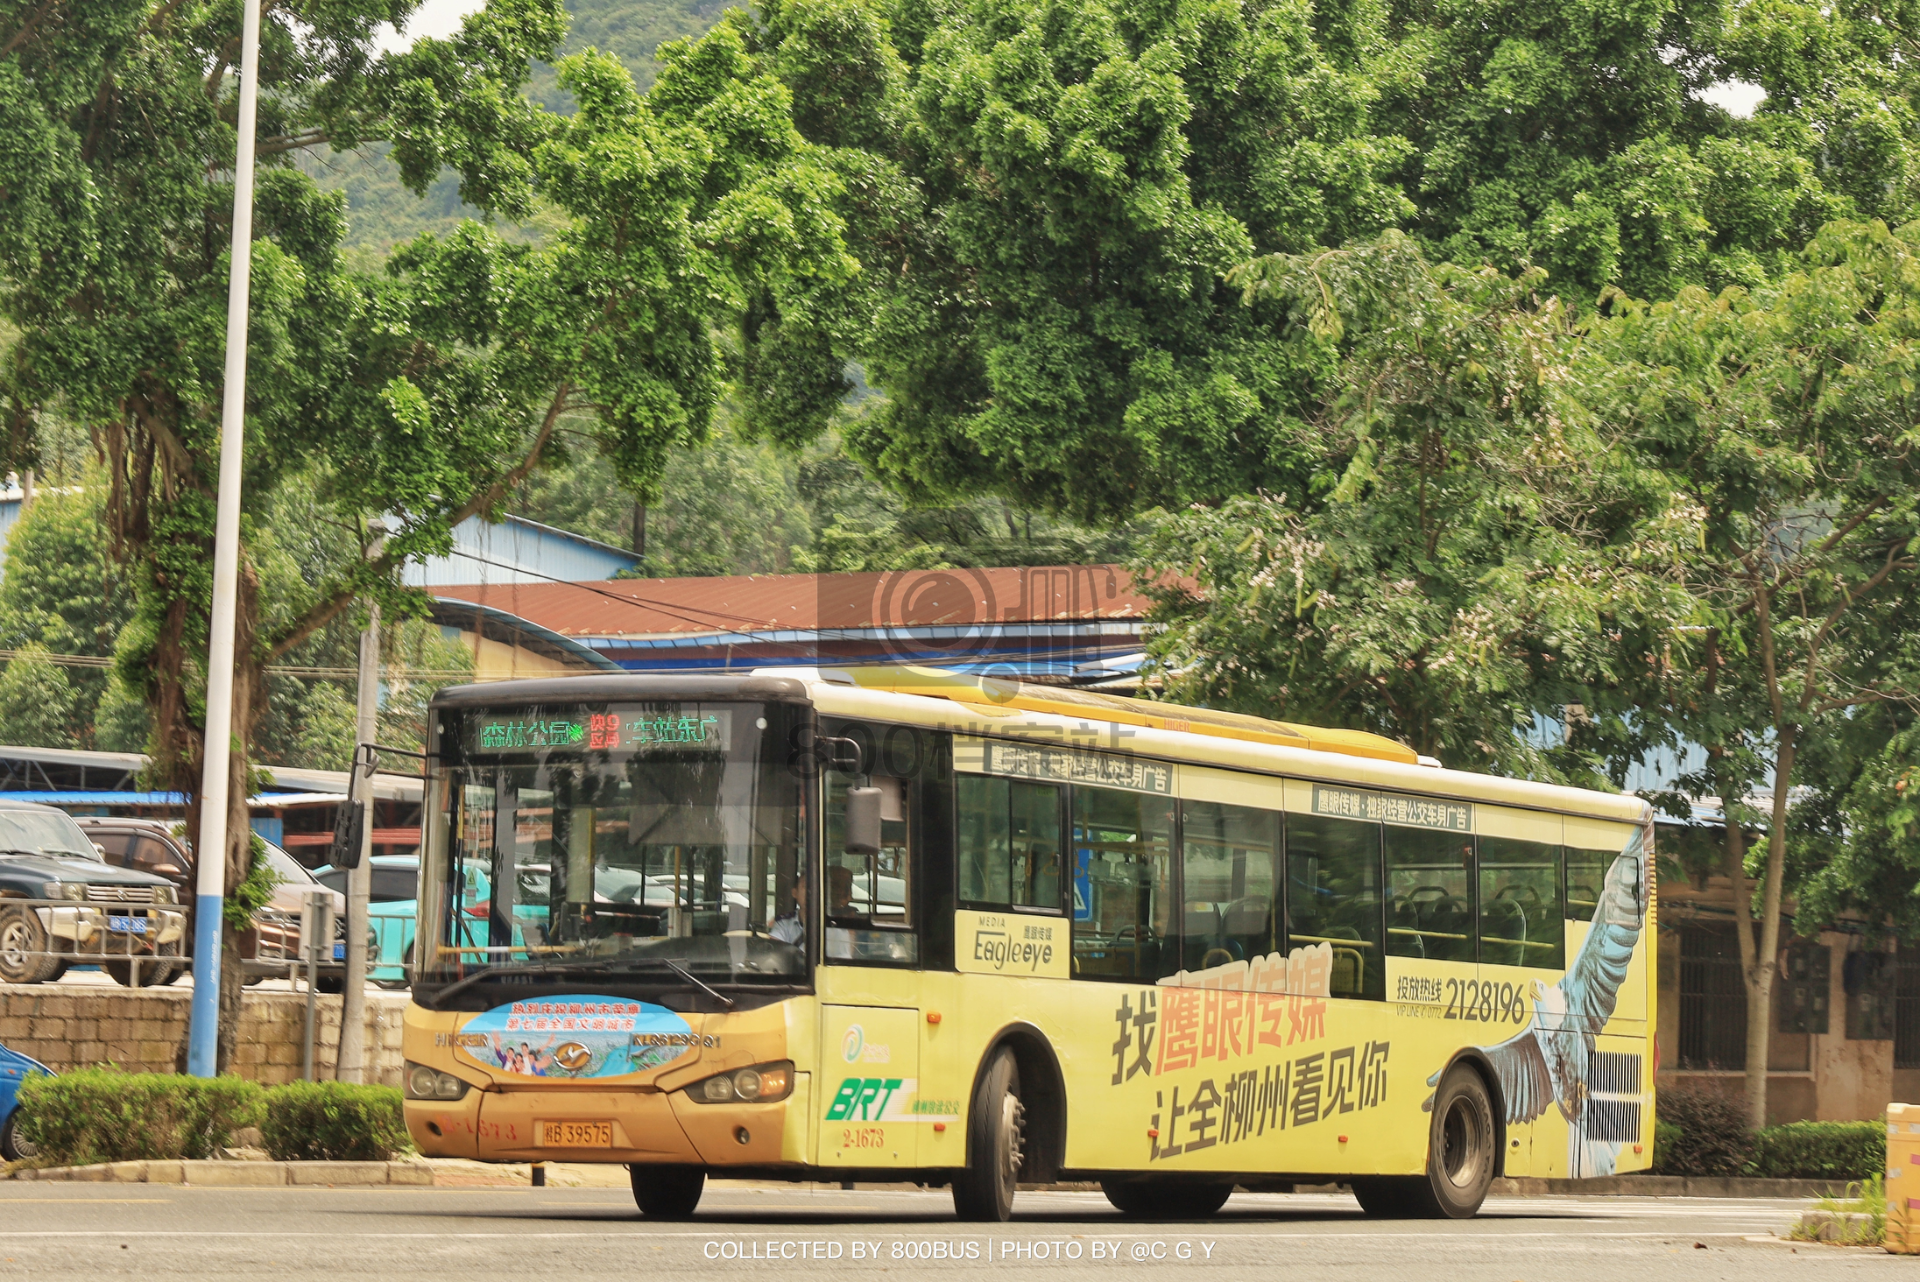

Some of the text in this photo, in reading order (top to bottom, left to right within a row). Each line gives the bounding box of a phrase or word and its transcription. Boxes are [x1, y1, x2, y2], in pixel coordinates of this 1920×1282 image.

[1164, 718, 1190, 732] HIGER
[979, 916, 1005, 928] MEDIA
[974, 930, 1052, 971] Eagleeye
[1397, 975, 1442, 1002] 投放热线
[1443, 977, 1525, 1025] 2128196
[1396, 1005, 1406, 1016] VIP
[1407, 1006, 1419, 1018] LINE
[825, 1078, 903, 1121] BRT
[1150, 1040, 1390, 1162] 让全柳州看见你
[843, 1128, 884, 1148] 2-1673
